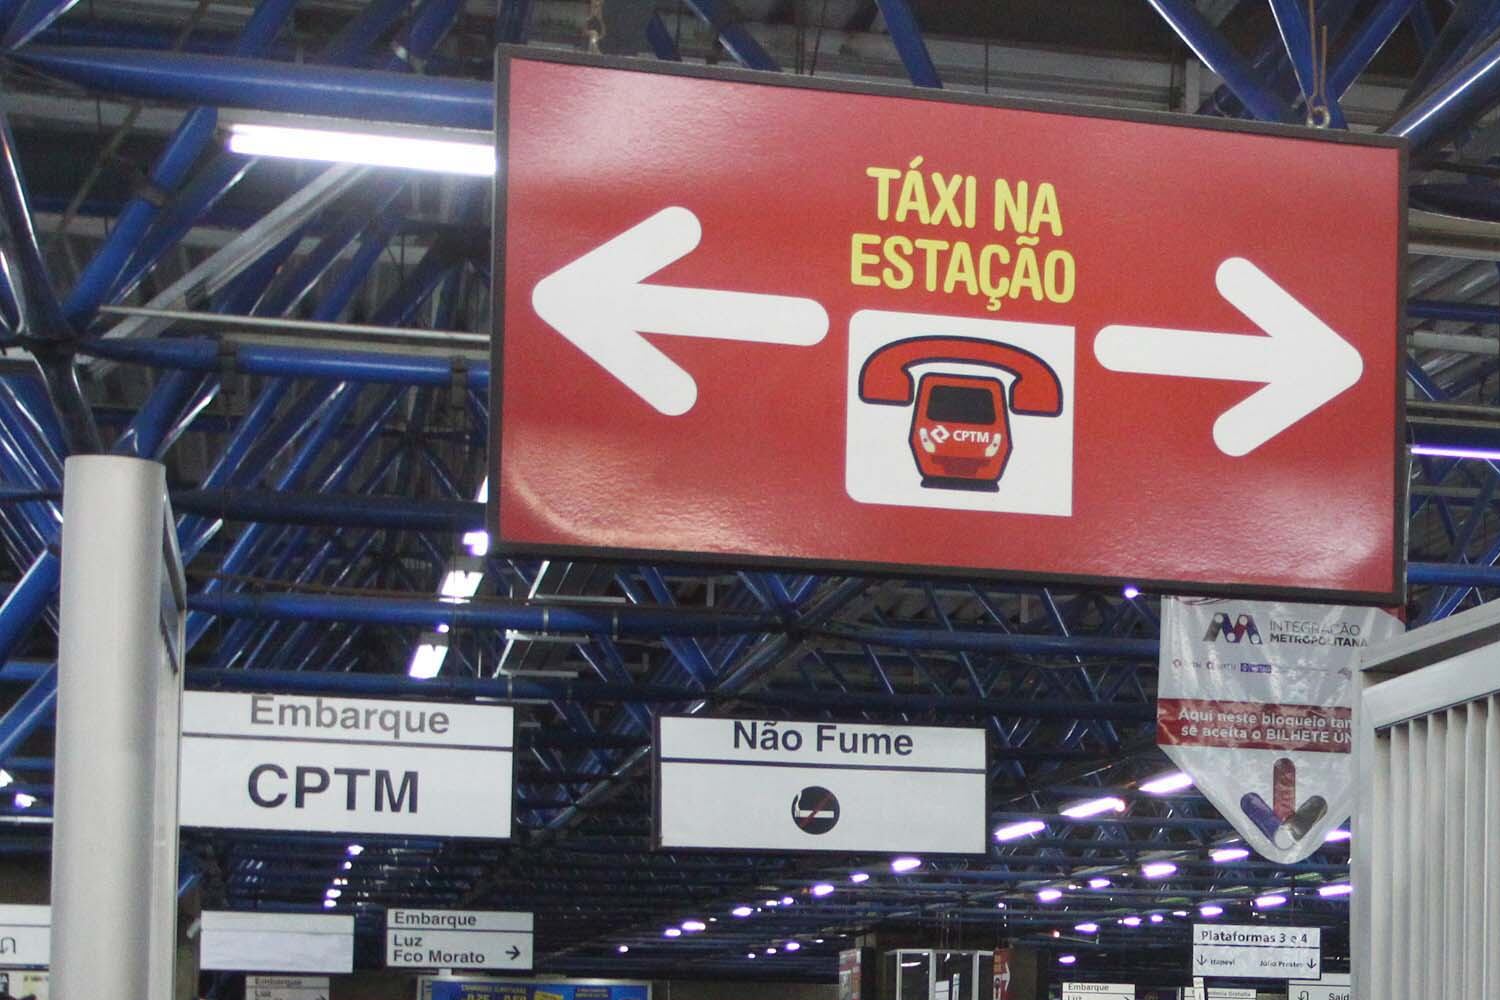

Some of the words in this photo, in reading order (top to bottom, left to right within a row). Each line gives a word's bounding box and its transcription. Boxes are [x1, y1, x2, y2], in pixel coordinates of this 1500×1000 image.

[866, 155, 977, 229] TÁXI
[994, 178, 1063, 237] NA
[851, 233, 1076, 311] ESTAÇÃO
[952, 430, 990, 443] CPTM
[1270, 619, 1361, 637] INTEGRAÇÃO
[1270, 633, 1368, 648] METROPOLITANA
[250, 694, 450, 739] Embarque
[1178, 708, 1214, 723] Aqui
[1217, 711, 1257, 724] neste
[1262, 712, 1326, 728] bloqueio
[733, 720, 803, 751] Não
[816, 724, 914, 756] Fume
[1202, 726, 1248, 738] aceita
[1252, 729, 1261, 740] o
[1266, 729, 1329, 743] BILHETE
[247, 763, 420, 814] CPTM
[394, 912, 477, 928] Embarque
[393, 934, 423, 947] Luz
[1201, 931, 1276, 943] Plataformas
[1279, 933, 1286, 943] 3
[1300, 933, 1308, 943] 4
[393, 950, 423, 963] Fco
[428, 950, 486, 964] Morato
[1067, 983, 1110, 992] Embarque
